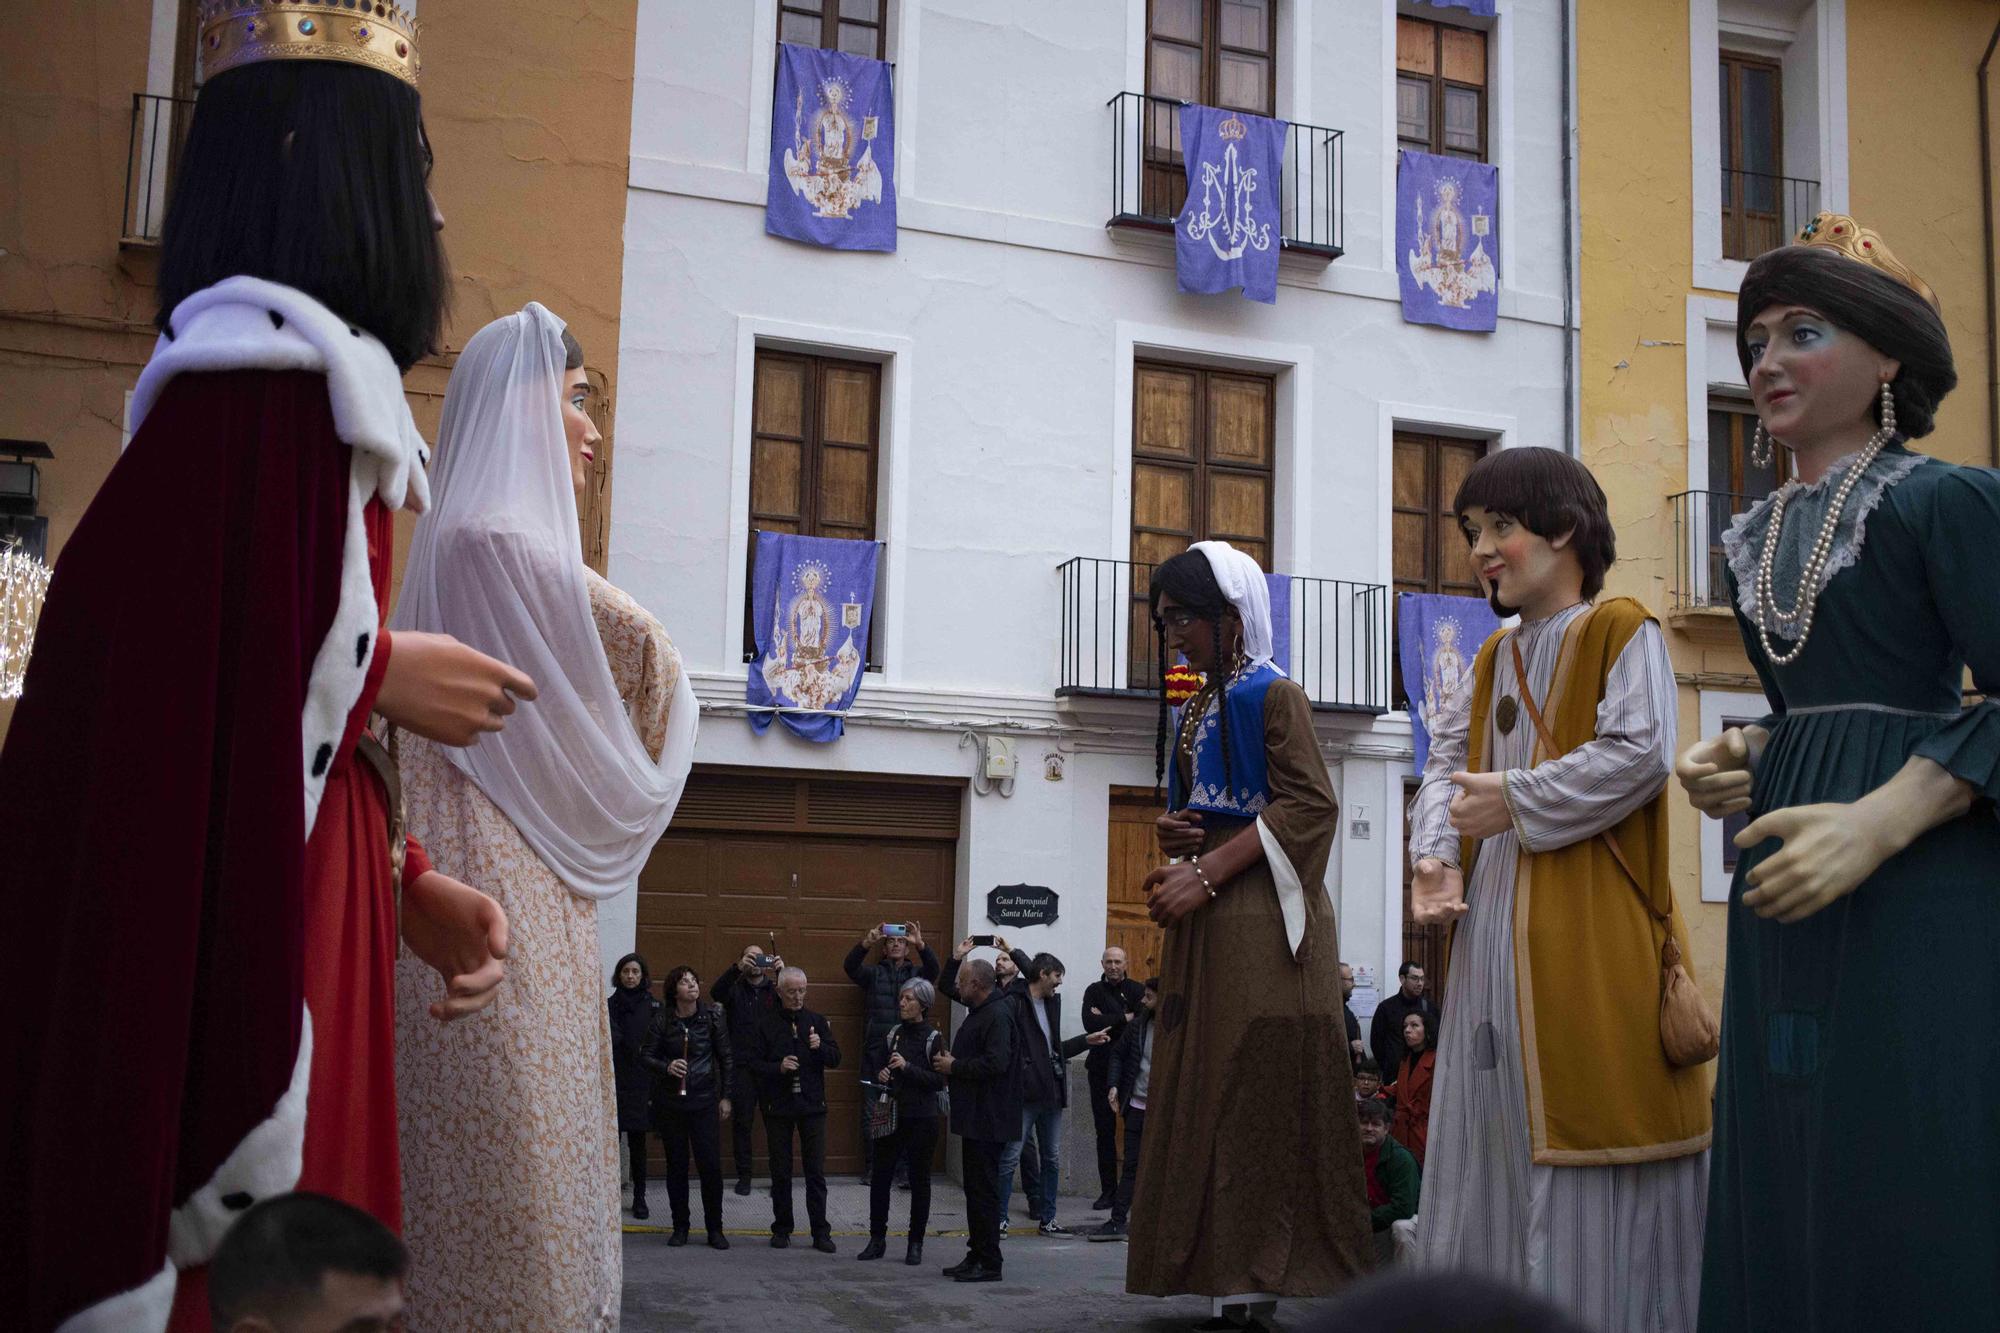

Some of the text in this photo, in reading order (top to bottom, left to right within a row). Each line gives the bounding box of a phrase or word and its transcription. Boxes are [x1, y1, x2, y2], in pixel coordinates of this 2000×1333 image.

[1358, 806, 1364, 818] 7
[996, 896, 1048, 908] Casa Parroquial
[1000, 908, 1020, 917] Santa
